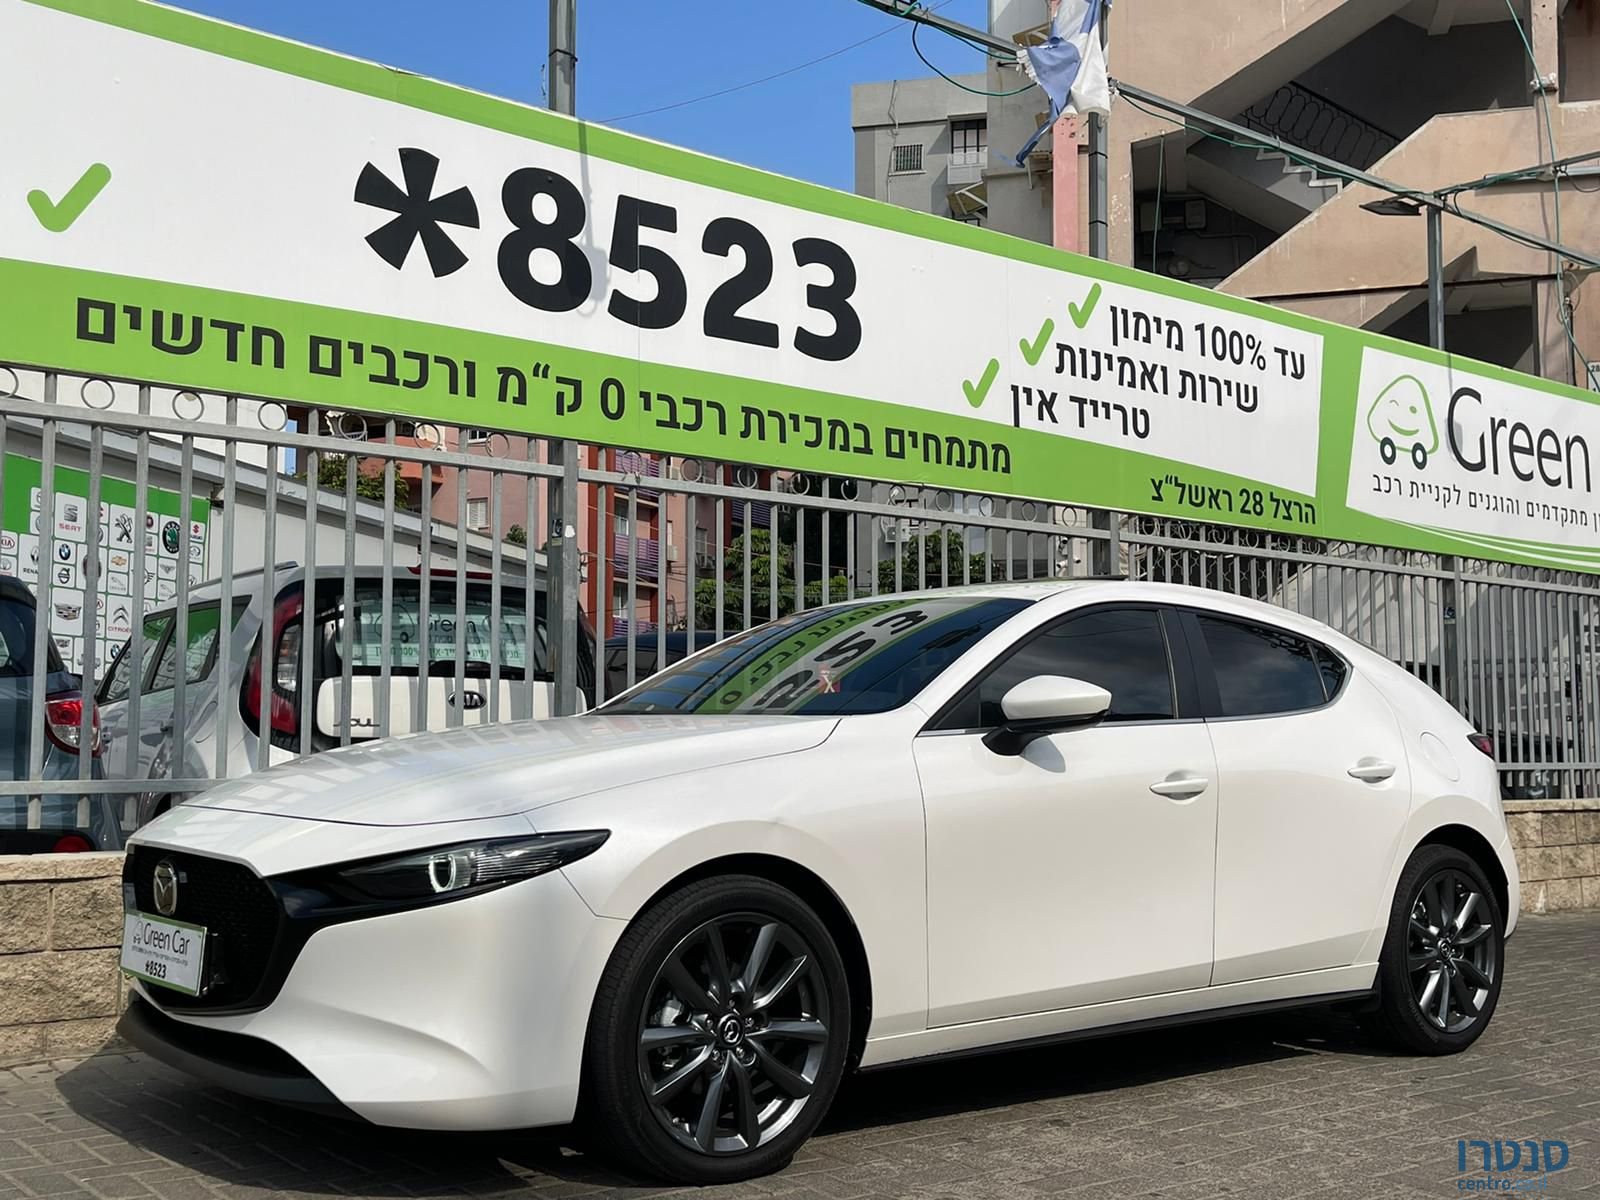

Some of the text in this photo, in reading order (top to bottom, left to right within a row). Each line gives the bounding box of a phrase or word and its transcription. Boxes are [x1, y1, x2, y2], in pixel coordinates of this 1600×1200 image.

[76, 297, 285, 369] חדשים
[1110, 305, 1305, 380] עד 100% מימון
[309, 335, 476, 398] ורכבים
[1055, 342, 1258, 413] שירות ואמינות
[600, 377, 625, 421] 0
[640, 390, 727, 436] רכבי
[1010, 384, 1151, 439] טרייד אין
[739, 405, 874, 456] במכירת
[885, 427, 1011, 475] מתמחים
[1447, 386, 1591, 493] Green
[1239, 488, 1264, 517] 28
[1269, 491, 1316, 525] הרצל
[1372, 474, 1402, 496] רכב
[1409, 480, 1461, 508] לקניית
[1468, 491, 1520, 515] והוגנים
[1526, 501, 1588, 527] מתקדמים
[143, 923, 170, 951] Green
[172, 930, 190, 956] Car
